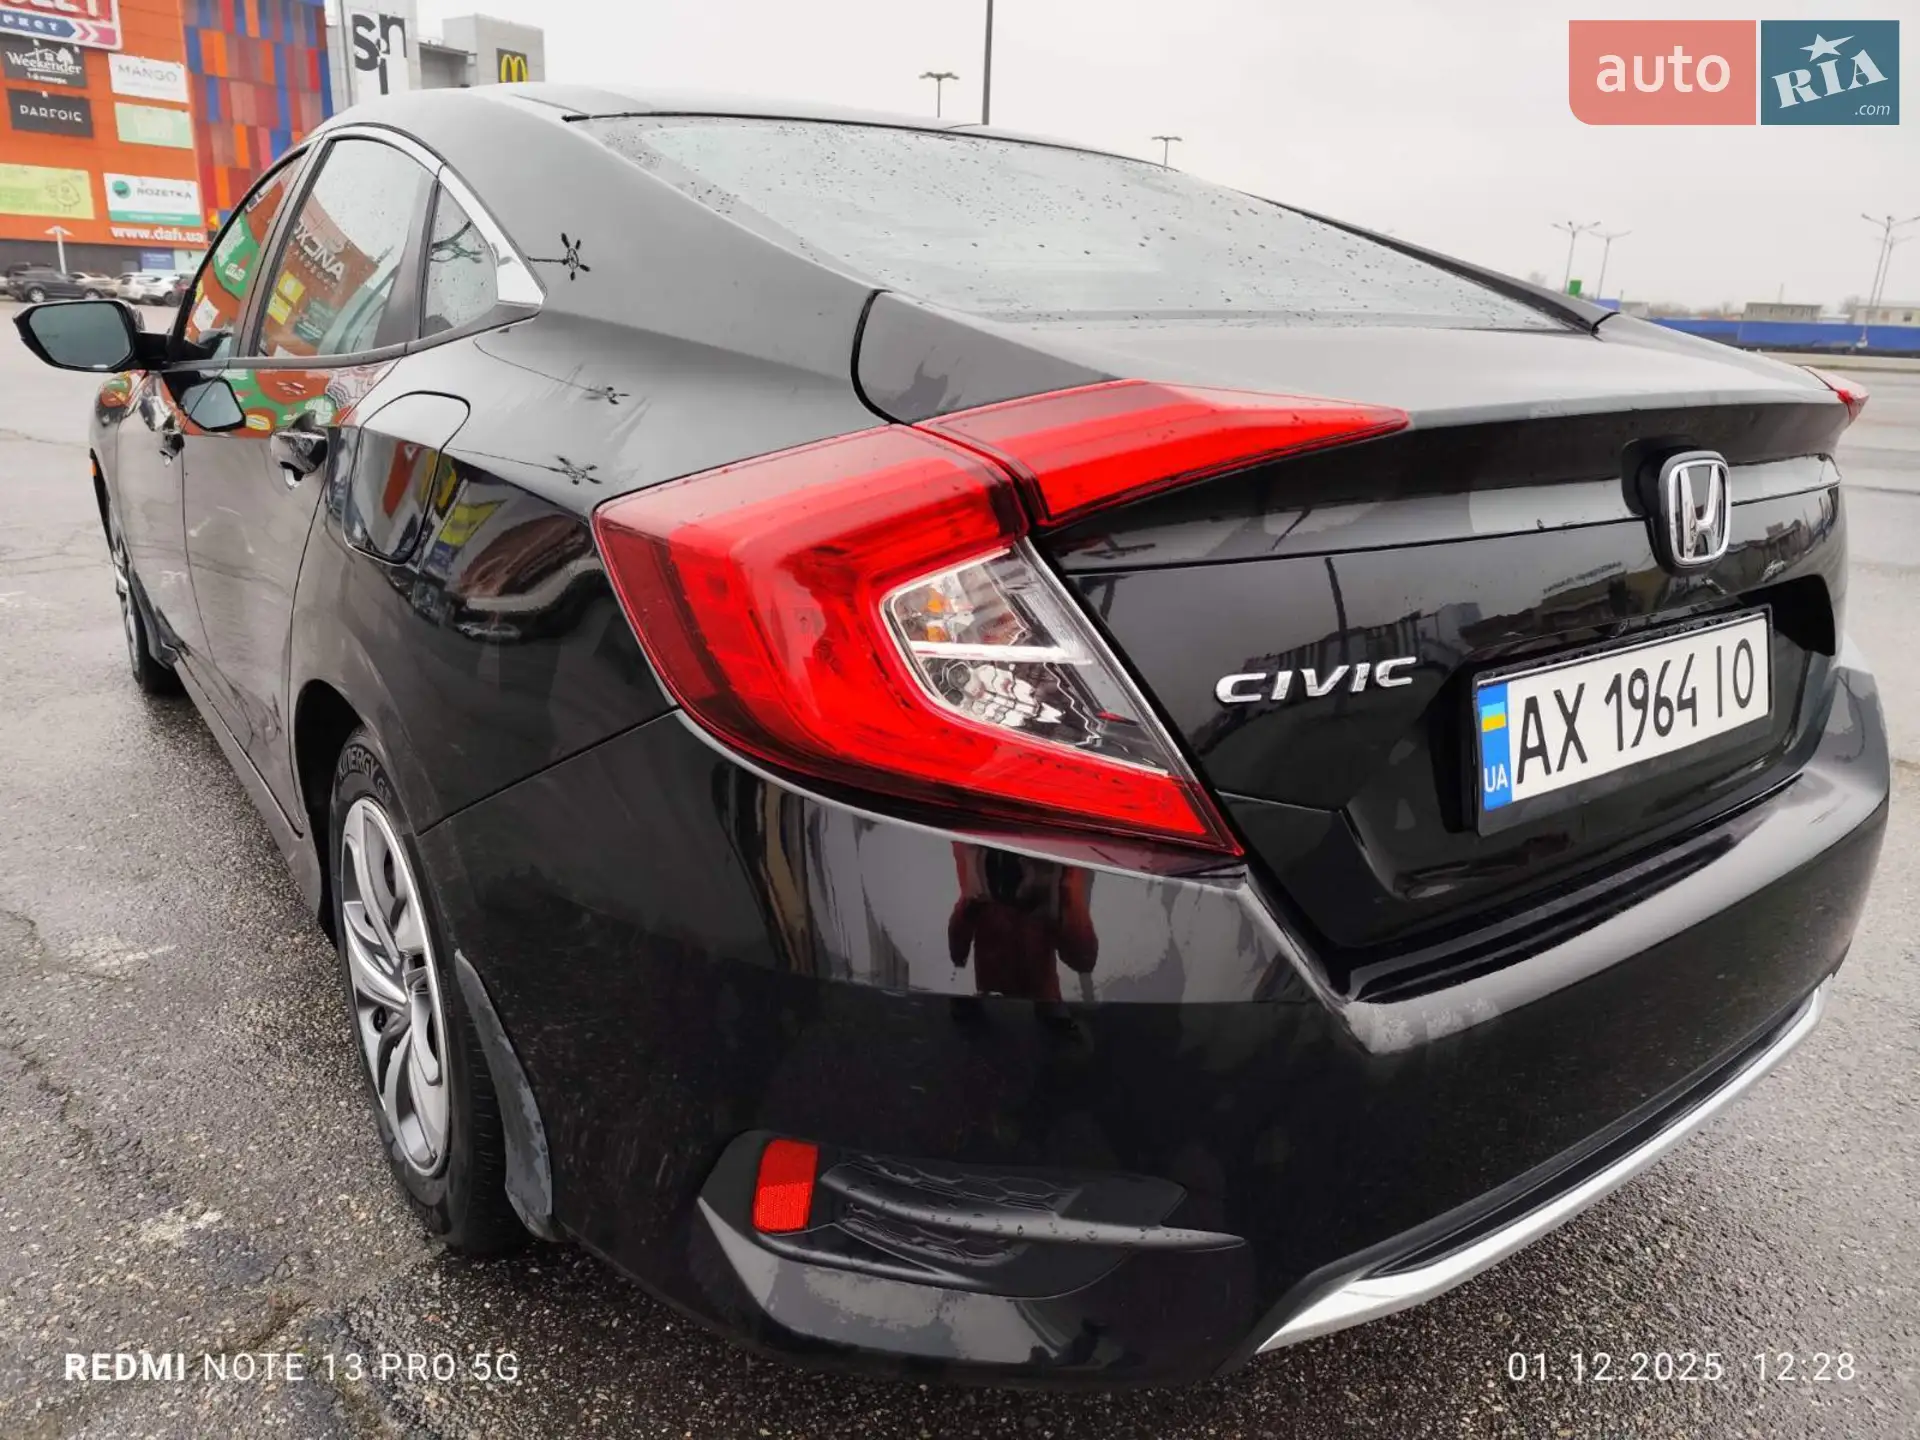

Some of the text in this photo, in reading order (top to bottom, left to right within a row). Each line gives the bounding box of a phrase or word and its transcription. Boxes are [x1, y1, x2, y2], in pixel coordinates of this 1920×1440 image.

[6, 50, 82, 75] Weekender
[118, 64, 178, 82] MANGO
[136, 187, 192, 200] ROZETKA
[1214, 655, 1418, 703] CIVIC
[1516, 637, 1755, 785] AX 1964 IO
[1484, 763, 1509, 793] UA
